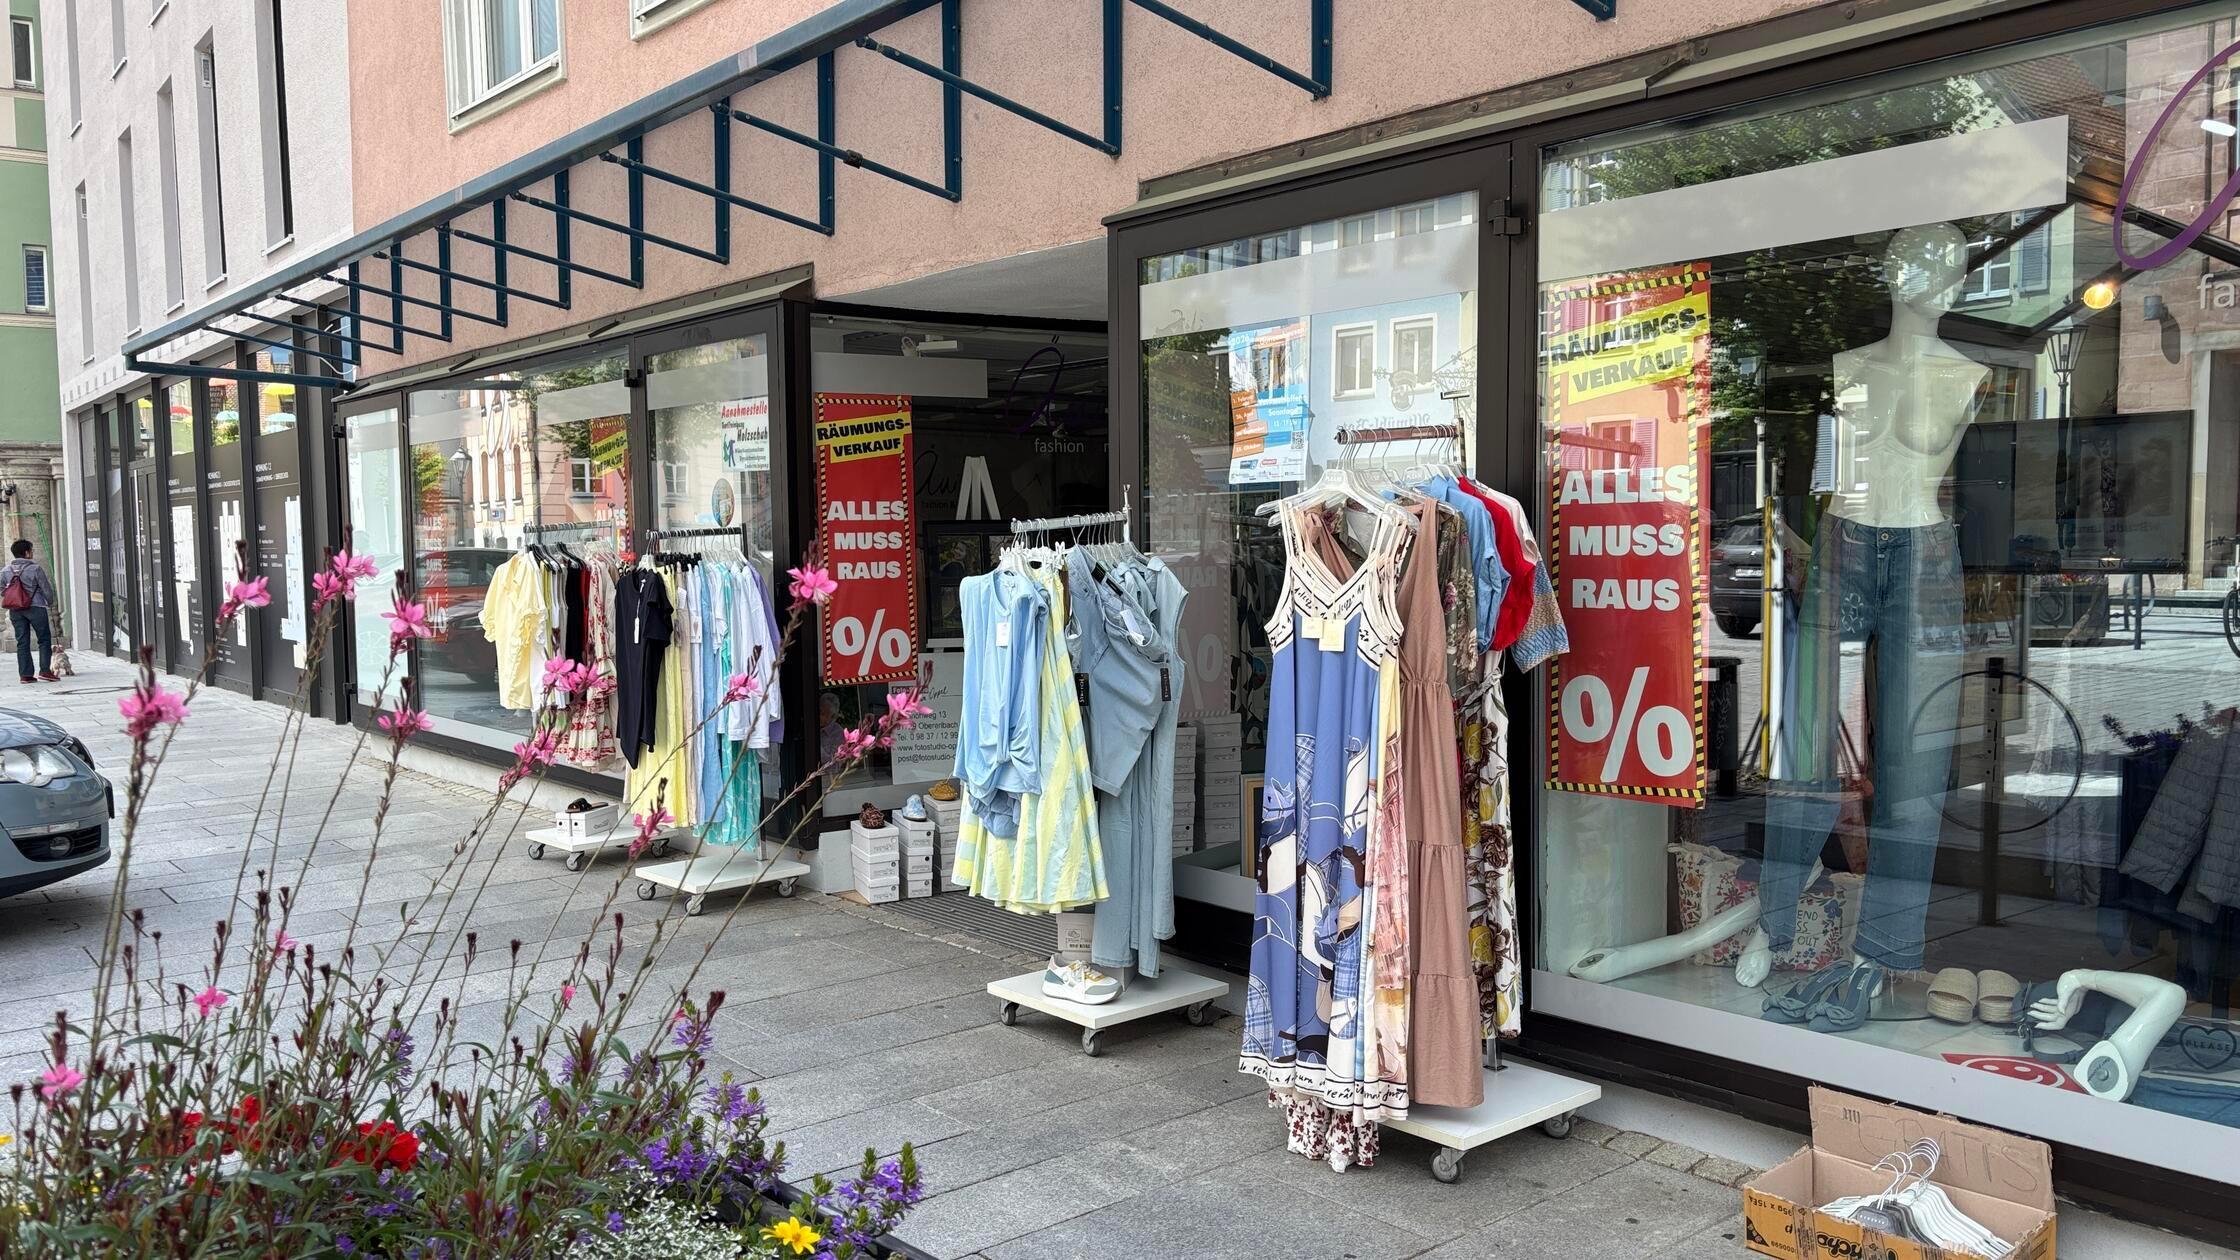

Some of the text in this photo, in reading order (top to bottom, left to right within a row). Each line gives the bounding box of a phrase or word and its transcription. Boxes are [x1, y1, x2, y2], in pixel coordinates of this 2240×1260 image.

[2196, 273, 2236, 310] fa
[1551, 307, 1706, 367] RÄUMUNGS-
[1572, 345, 1688, 393] VERKAUF
[721, 401, 768, 418] Annahmestelle
[737, 427, 768, 441] Holzschuh
[817, 418, 910, 440] RÄUMUNGS-
[832, 439, 902, 458] VERKAUF
[1034, 438, 1085, 453] fashion
[1560, 465, 1691, 505] ALLES
[827, 500, 905, 521] ALLES
[834, 532, 903, 550] MUSS
[1569, 524, 1686, 556] MUSS
[837, 561, 901, 580] RAUS
[1572, 578, 1681, 611] RAUS
[832, 608, 911, 677] %
[940, 710, 947, 718] 13
[1561, 666, 1694, 783] %
[927, 732, 934, 740] 37
[950, 731, 958, 739] 99
[897, 743, 957, 751] www.fotostudio-op
[898, 753, 956, 763] post@fotostudio-o
[1797, 910, 1819, 921] END
[2186, 1039, 2231, 1052] PLEASE
